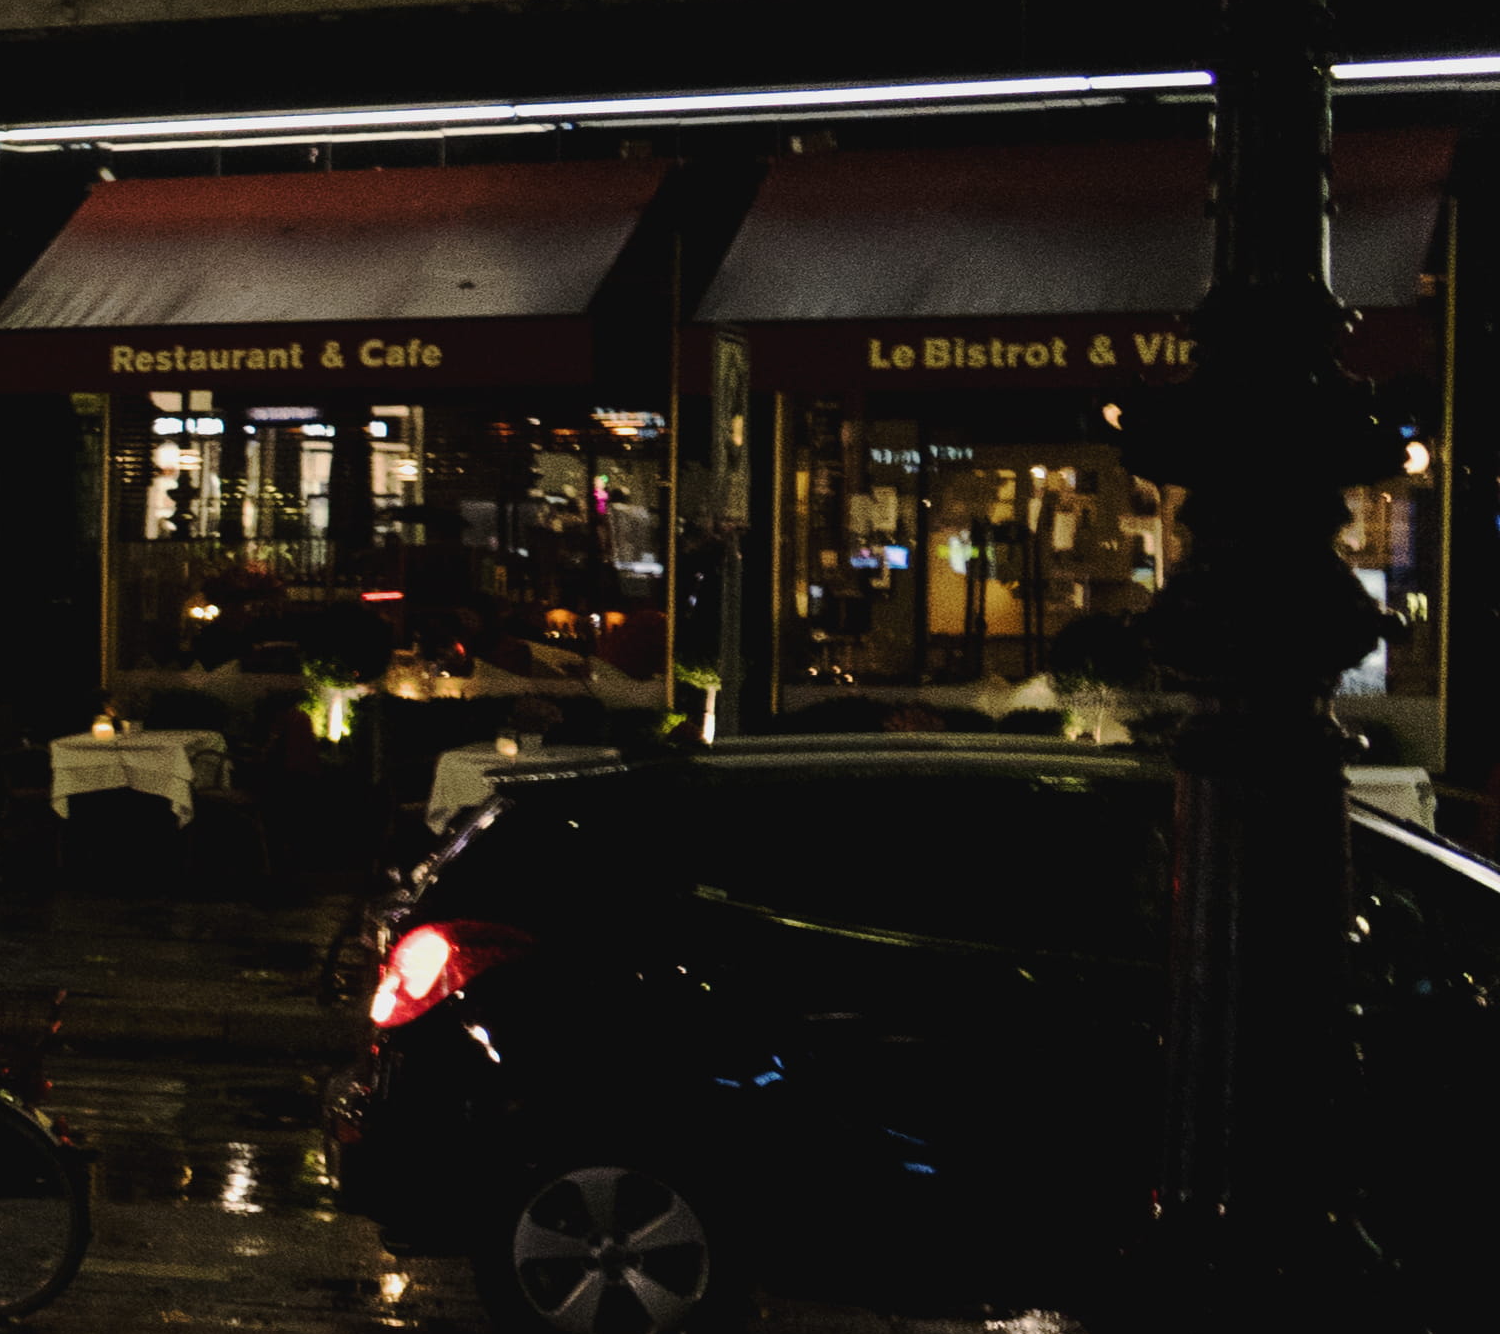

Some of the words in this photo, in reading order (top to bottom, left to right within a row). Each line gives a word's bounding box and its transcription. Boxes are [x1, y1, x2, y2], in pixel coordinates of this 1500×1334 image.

[111, 344, 303, 373] Restaurant
[320, 340, 344, 369] &
[359, 338, 442, 368] Cafe
[1088, 335, 1116, 366] &
